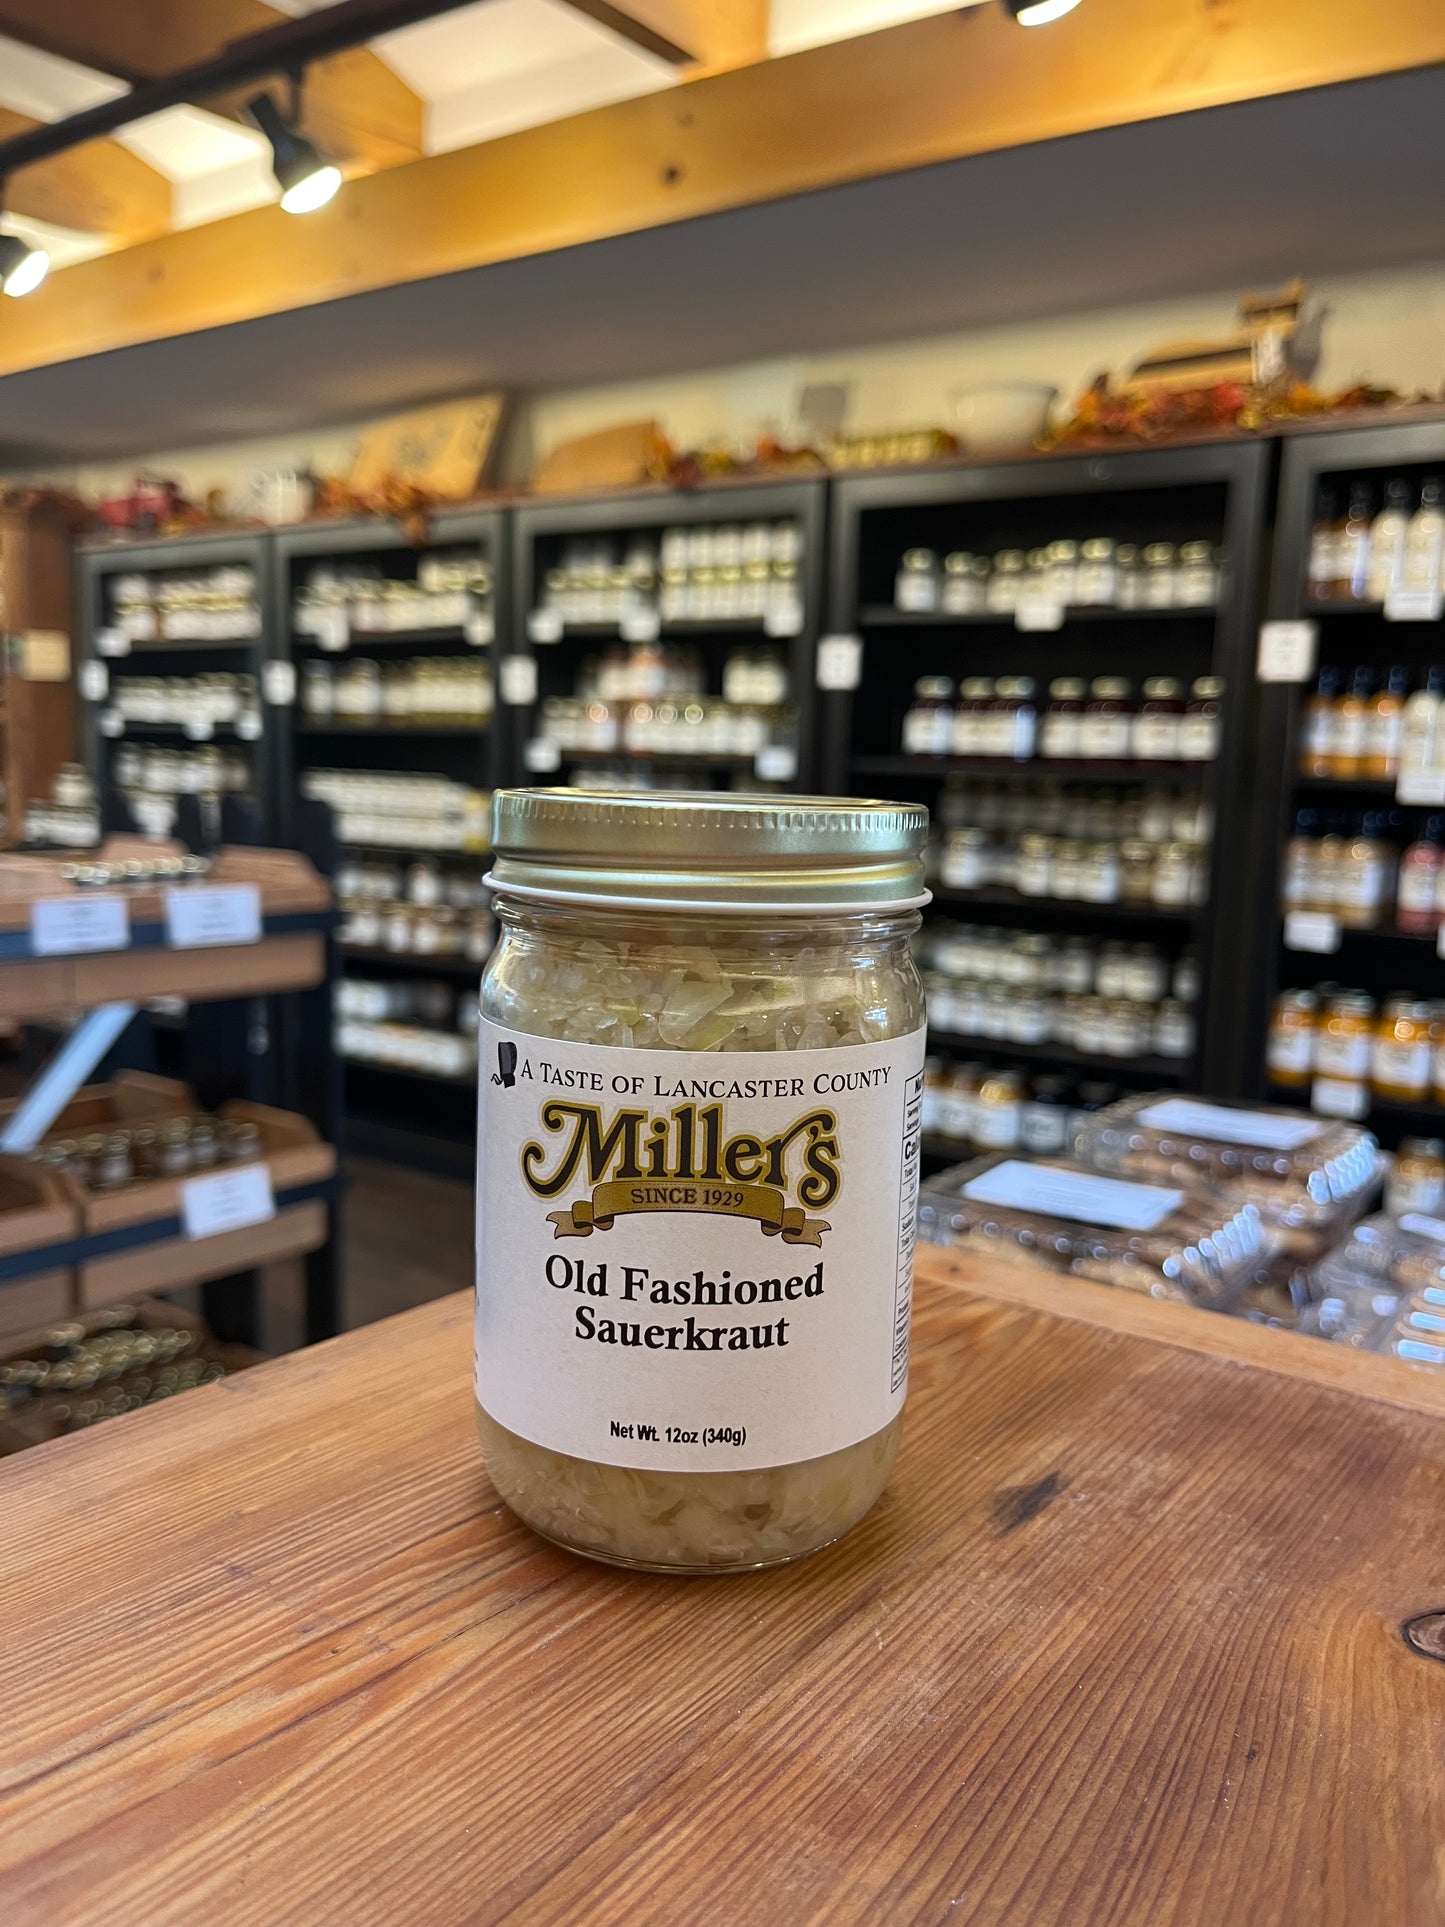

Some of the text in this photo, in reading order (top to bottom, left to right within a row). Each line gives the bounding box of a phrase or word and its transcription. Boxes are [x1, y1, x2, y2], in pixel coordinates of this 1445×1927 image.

[520, 1058, 534, 1080] A
[611, 1075, 645, 1095] OF
[521, 1101, 841, 1208] Miller's
[630, 1187, 744, 1207] SINCE 1929
[545, 1254, 825, 1306] Old Fashioned
[575, 1303, 790, 1351] Sauerkraut
[610, 1420, 747, 1448] Net Wt. 12oz (340g)
